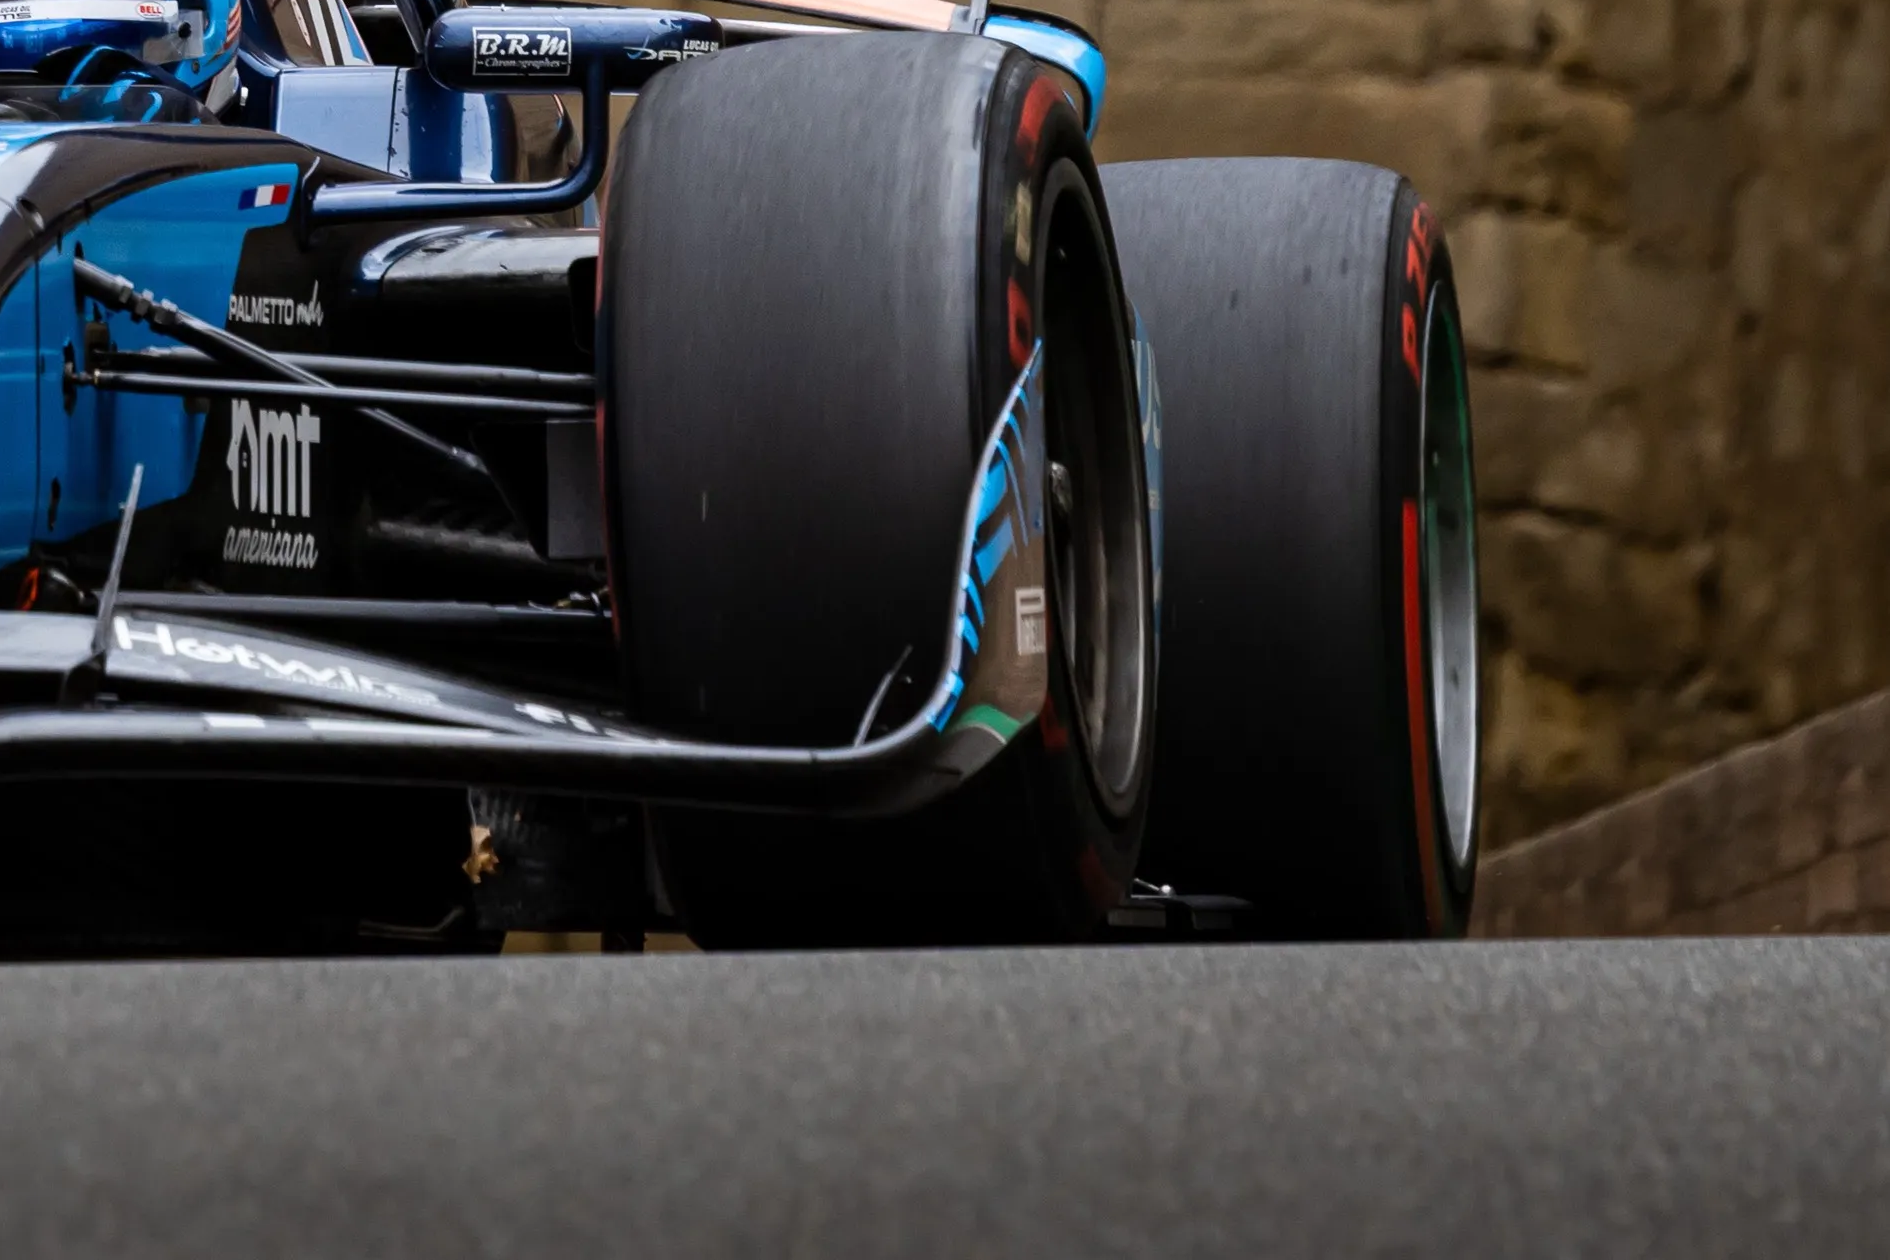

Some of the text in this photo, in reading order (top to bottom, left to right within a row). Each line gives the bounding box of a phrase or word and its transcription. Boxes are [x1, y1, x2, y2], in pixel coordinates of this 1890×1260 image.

[139, 5, 163, 14] BELL
[683, 39, 710, 52] LUCAS
[228, 294, 295, 326] PALMETTO
[223, 518, 318, 569] americana
[113, 615, 441, 706] Hotwire
